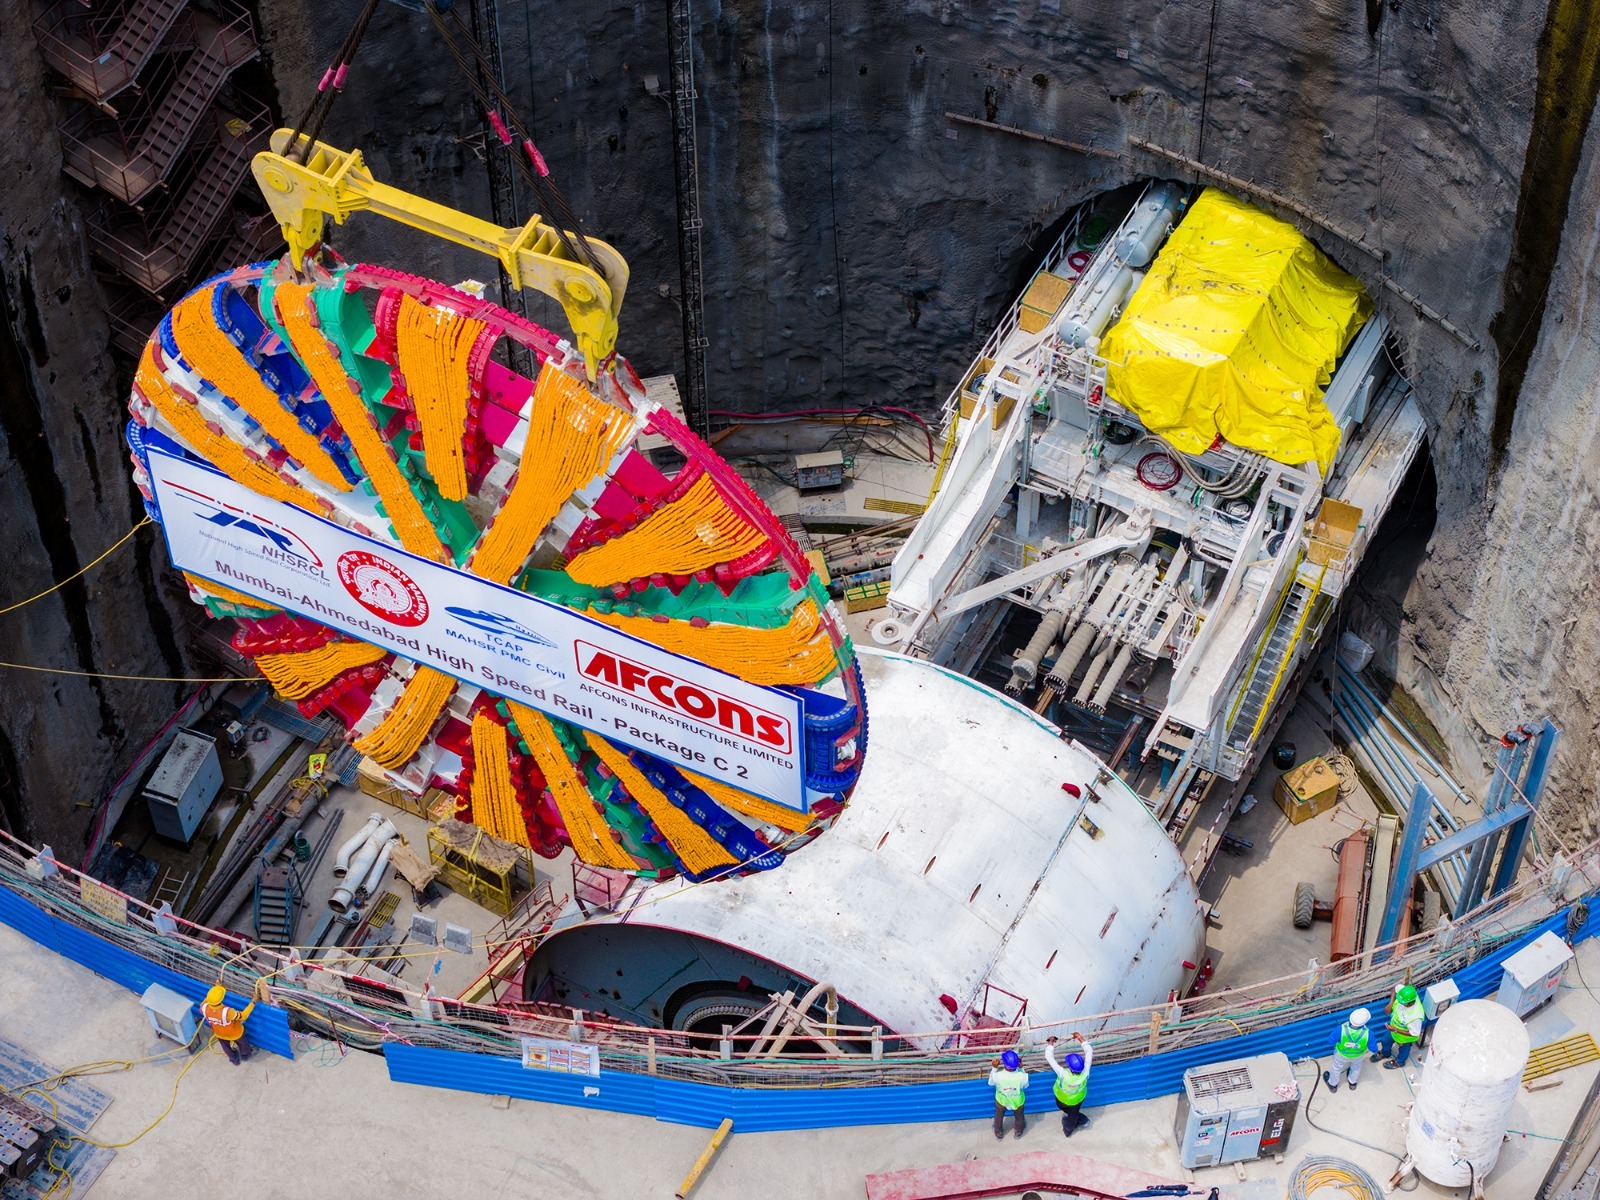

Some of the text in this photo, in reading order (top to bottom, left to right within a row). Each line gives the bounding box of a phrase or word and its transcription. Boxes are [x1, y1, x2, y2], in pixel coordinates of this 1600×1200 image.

[199, 530, 333, 588] National High Speed Rail Corporation Ltd.
[262, 545, 330, 581] NHSRCL
[371, 556, 427, 621] INDIAN RAILWAYS
[214, 559, 420, 652] Mumbai-Ahmedabad
[426, 644, 475, 673] High
[480, 666, 546, 702] Speed
[553, 693, 593, 720] Rail
[614, 717, 706, 763] Package
[714, 756, 729, 772] C
[736, 765, 749, 780] 2
[445, 628, 566, 679] MAHSR PMC Civil
[484, 633, 523, 652] TCAP
[579, 682, 794, 770] AFCONS INFRASTRUCTURE LIMITED
